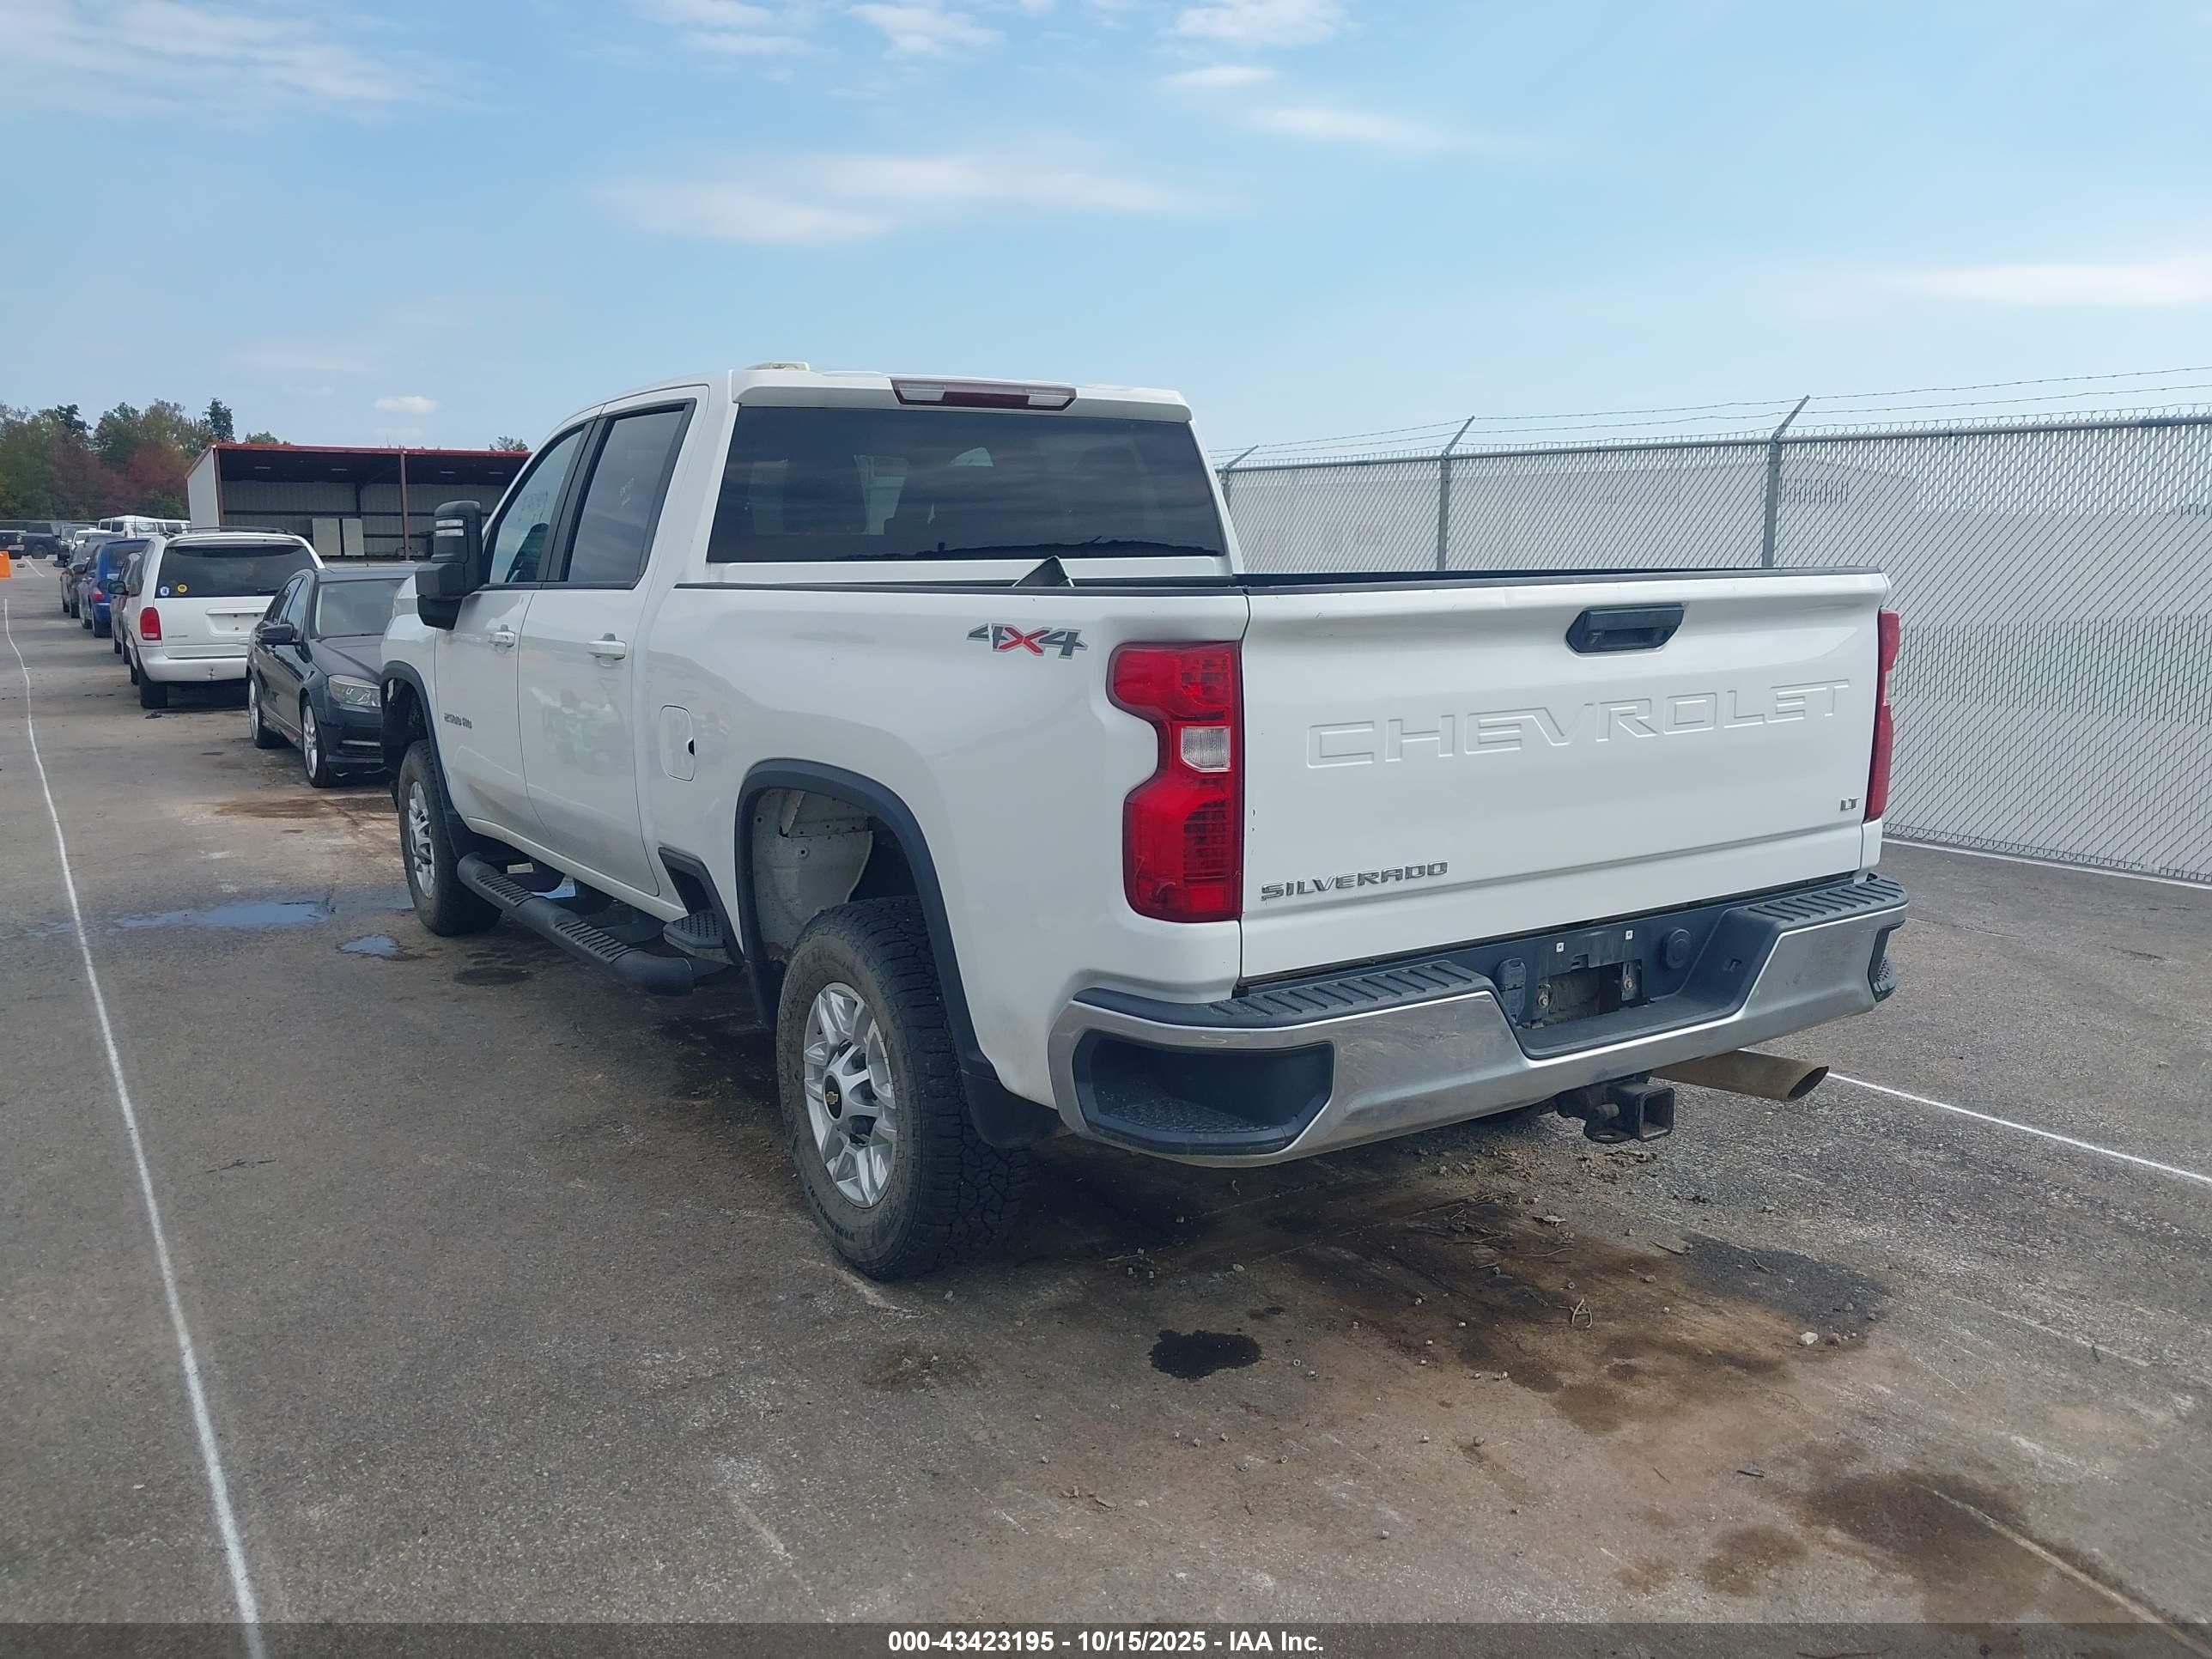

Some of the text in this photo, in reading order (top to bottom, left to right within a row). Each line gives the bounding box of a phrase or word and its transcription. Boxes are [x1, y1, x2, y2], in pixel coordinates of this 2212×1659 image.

[1306, 679, 1850, 769] CHEVROLET
[1840, 797, 1861, 811] LT
[1261, 860, 1449, 901] SILVERADO
